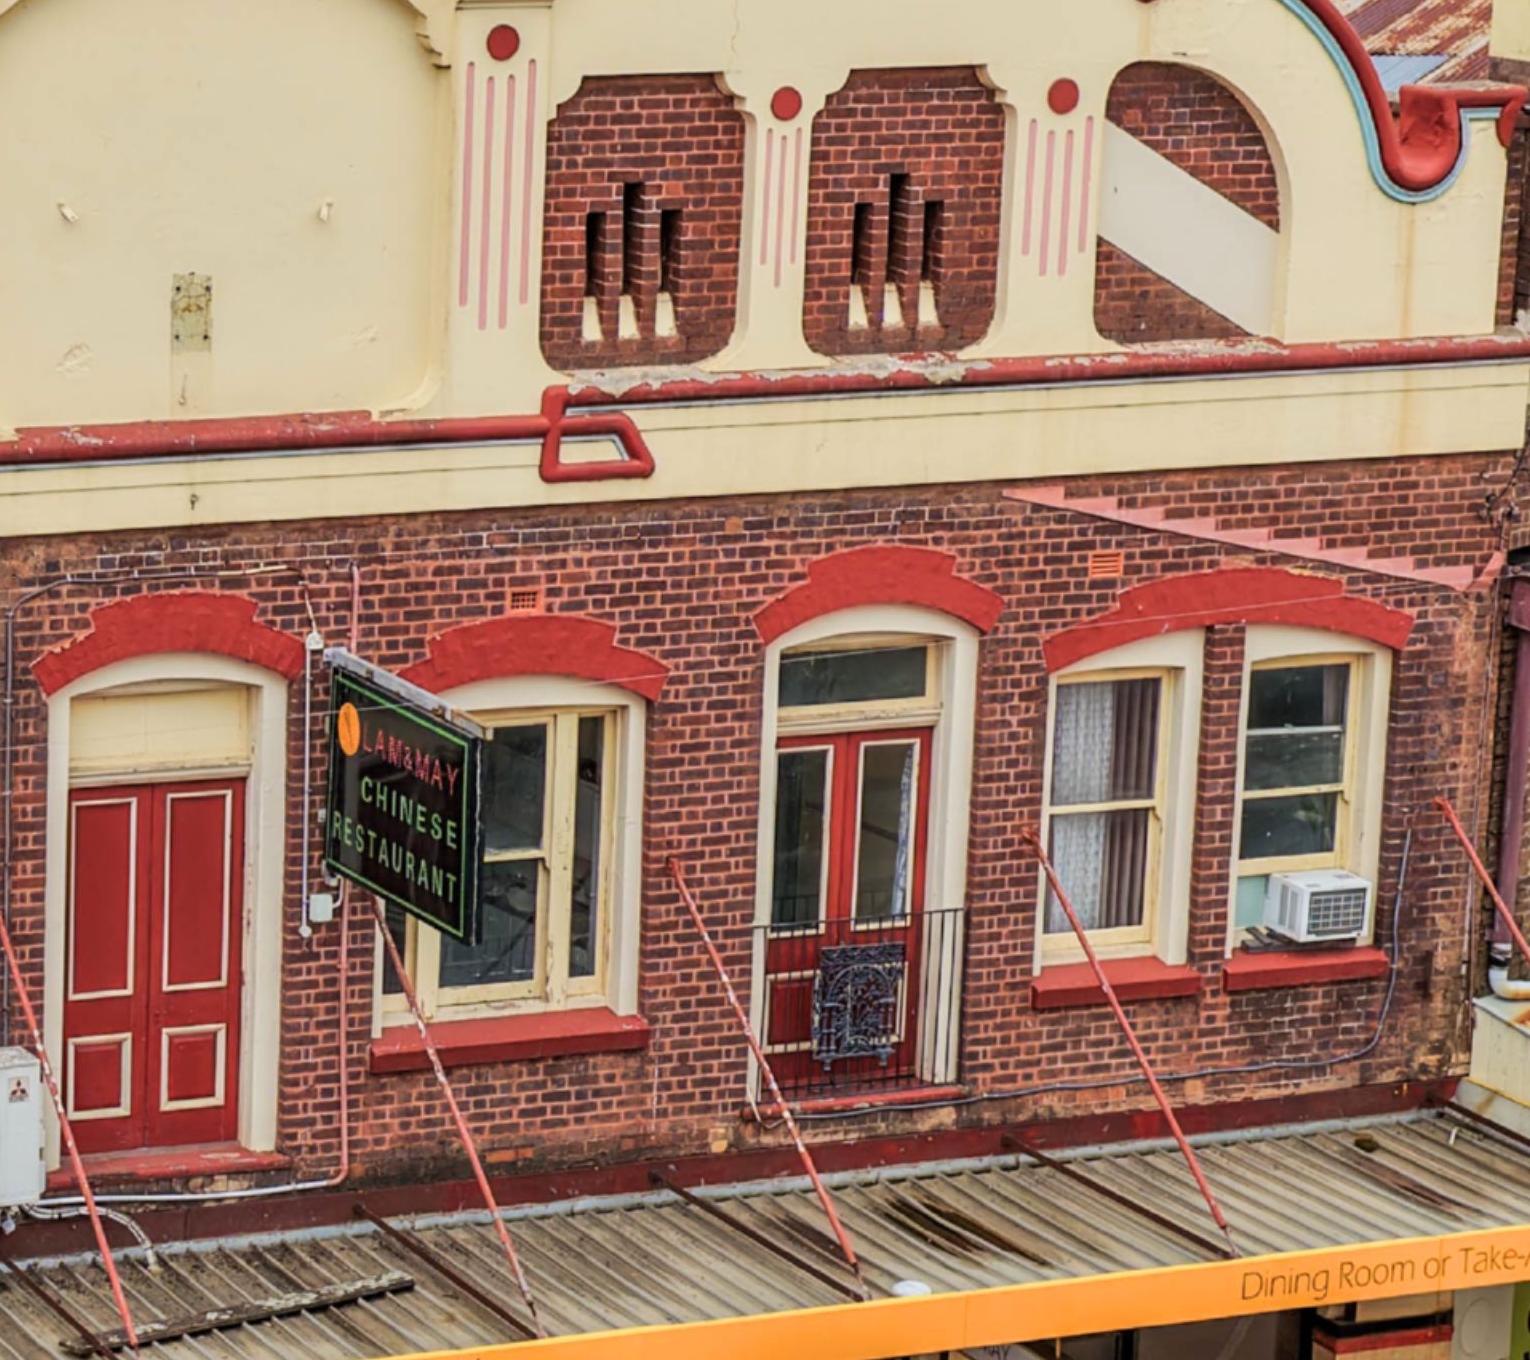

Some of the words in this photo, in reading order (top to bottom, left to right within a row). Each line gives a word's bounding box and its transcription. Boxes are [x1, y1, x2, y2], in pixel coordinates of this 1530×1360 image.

[360, 775, 458, 850] CHINESE
[332, 810, 457, 903] RESTAURANT
[1241, 1268, 1330, 1301] Dining
[1338, 1257, 1416, 1290] Room
[1423, 1252, 1452, 1279] or
